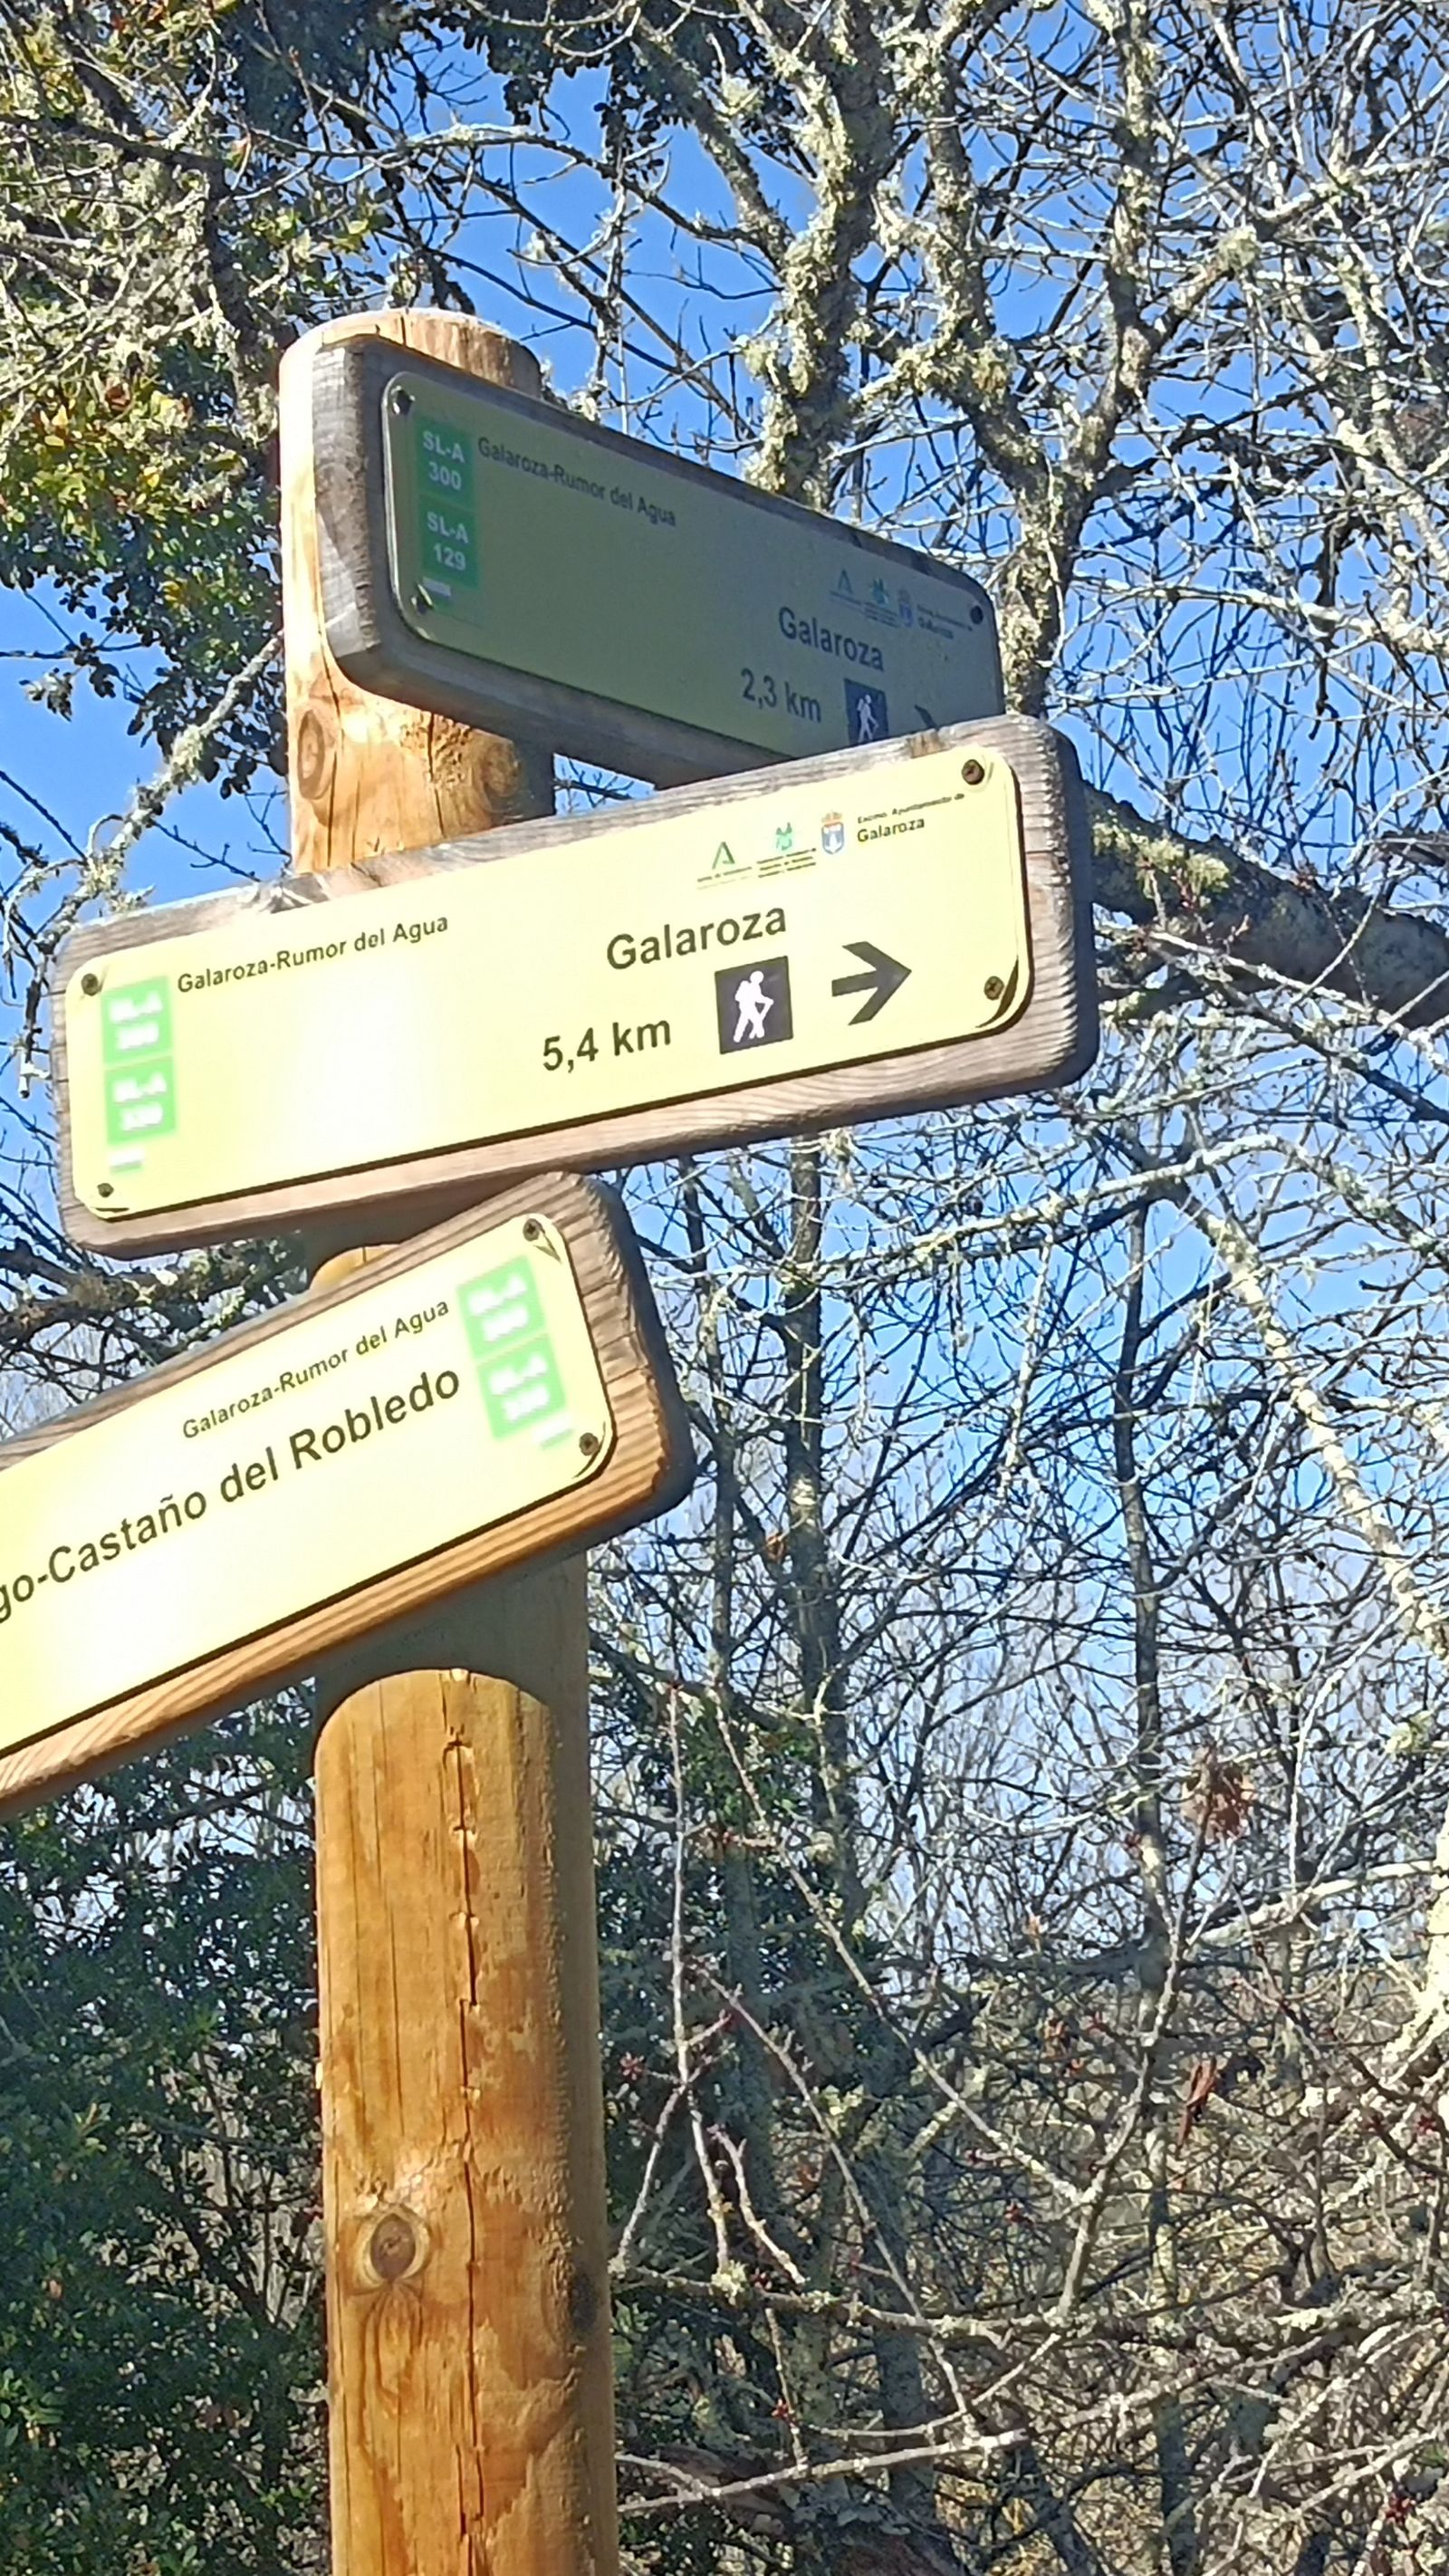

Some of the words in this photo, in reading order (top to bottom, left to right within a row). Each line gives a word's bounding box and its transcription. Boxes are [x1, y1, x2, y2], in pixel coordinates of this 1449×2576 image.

[423, 430, 465, 464] SL-A
[429, 461, 462, 490] 300
[478, 437, 606, 500] Galaroza-Rumor
[610, 485, 633, 511] del
[638, 496, 677, 526] Agua
[427, 512, 469, 544] SL-A
[433, 543, 466, 571] 129
[778, 606, 885, 672] Galaroza
[741, 668, 778, 711] 2,3
[785, 682, 821, 723] km
[857, 819, 925, 842] Galaroza
[178, 940, 347, 993] Galaroza-Rumor
[354, 928, 385, 952] del
[393, 917, 449, 944] Agua
[607, 908, 787, 970] Galaroza
[543, 1027, 599, 1073] 5,4
[613, 1020, 672, 1056] km
[182, 1350, 349, 1438] Galaroza-Rumor
[356, 1326, 388, 1355] del
[394, 1301, 449, 1338] Agua
[220, 1447, 279, 1504] del
[289, 1370, 460, 1469] Robledo
